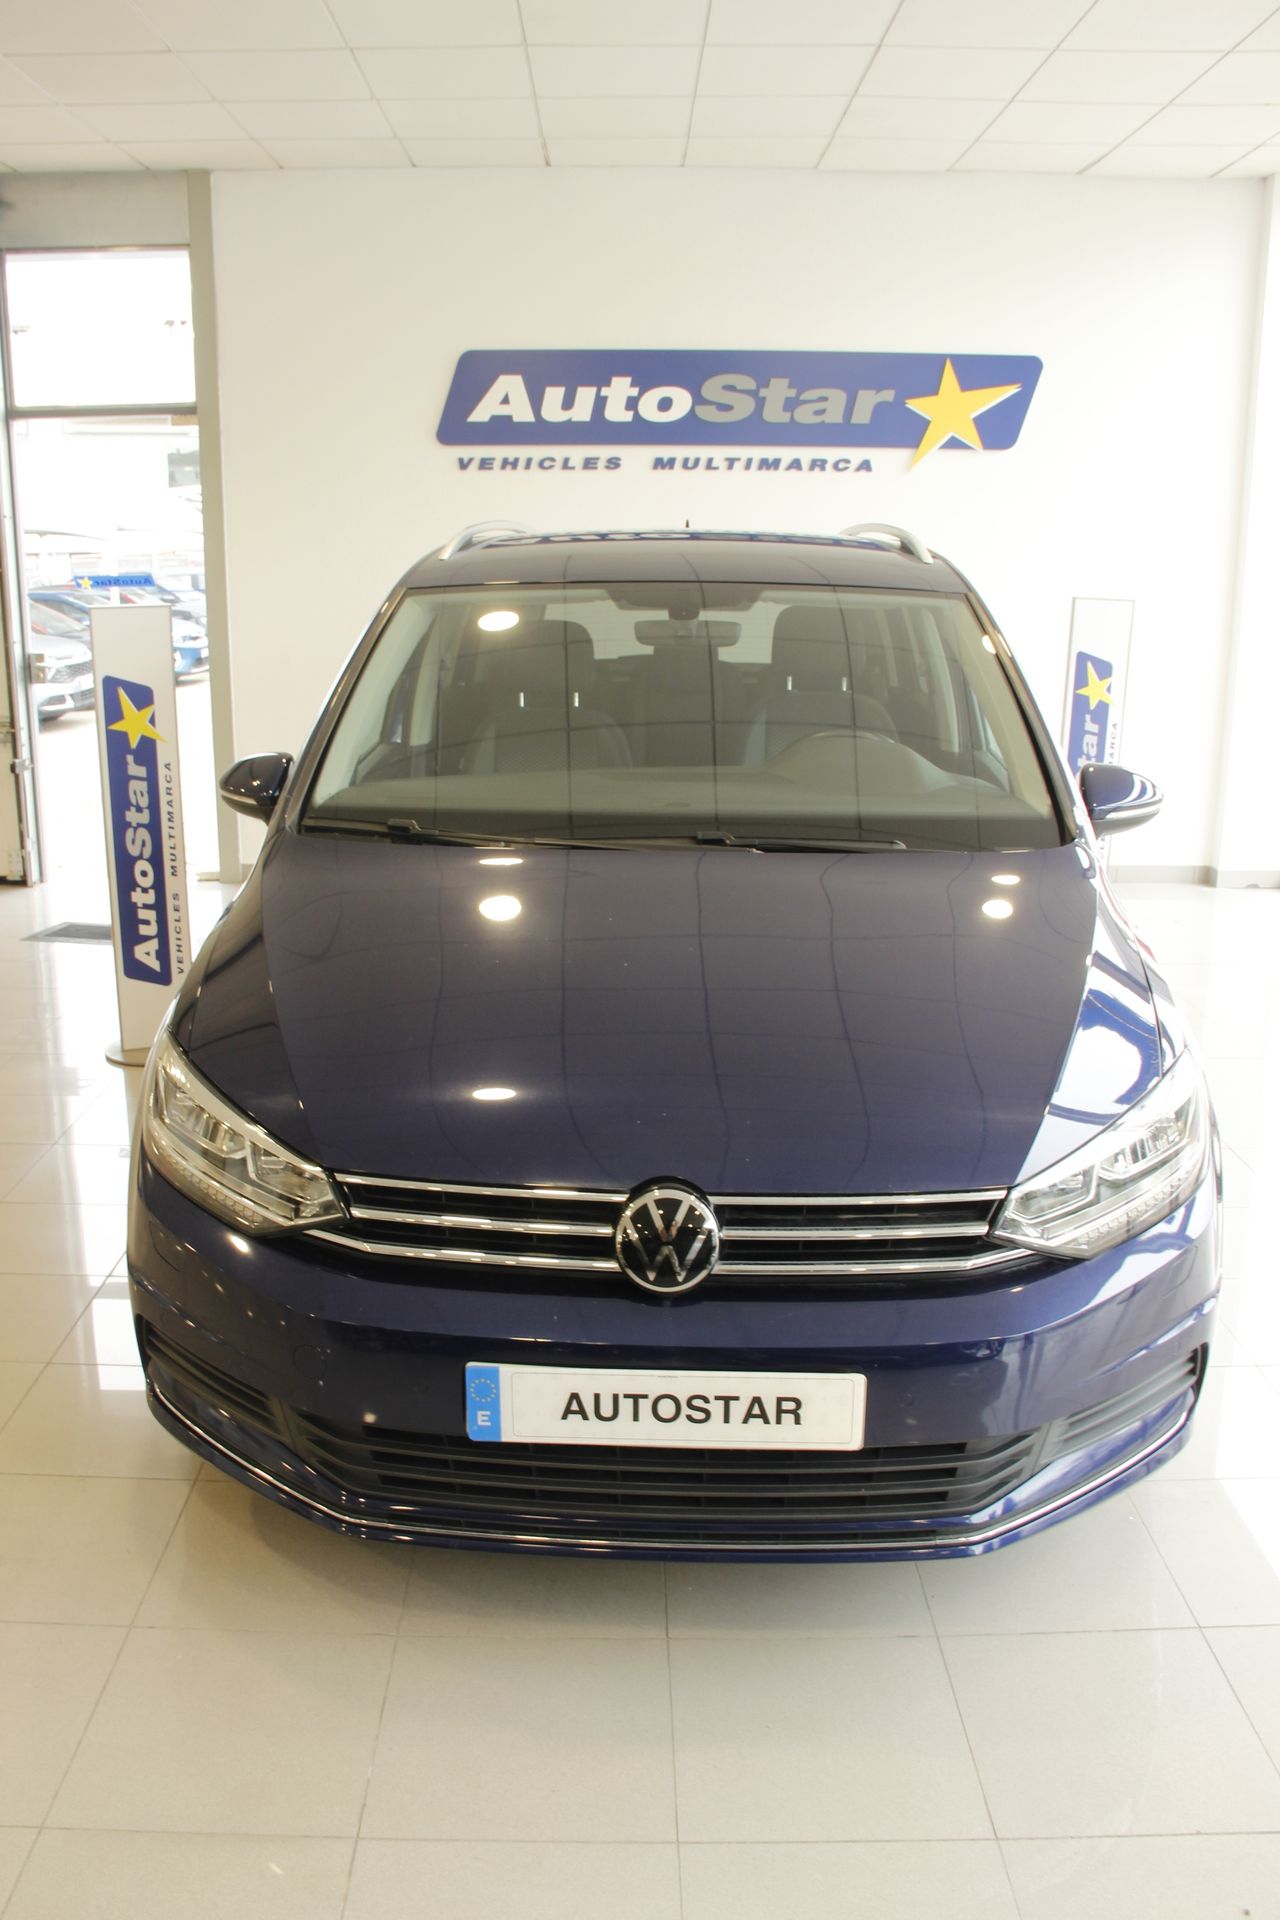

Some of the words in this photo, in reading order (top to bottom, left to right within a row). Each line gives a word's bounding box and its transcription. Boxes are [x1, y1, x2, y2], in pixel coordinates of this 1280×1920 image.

[466, 374, 896, 424] AutoStar
[458, 457, 622, 470] VEHICLES
[652, 457, 873, 472] MULTIMARCA
[163, 762, 178, 877] MULTIMARCA
[126, 754, 161, 972] AutoStar
[171, 893, 184, 974] VEHICLES
[477, 1410, 491, 1426] E
[560, 1392, 803, 1426] AUTOSTAR
